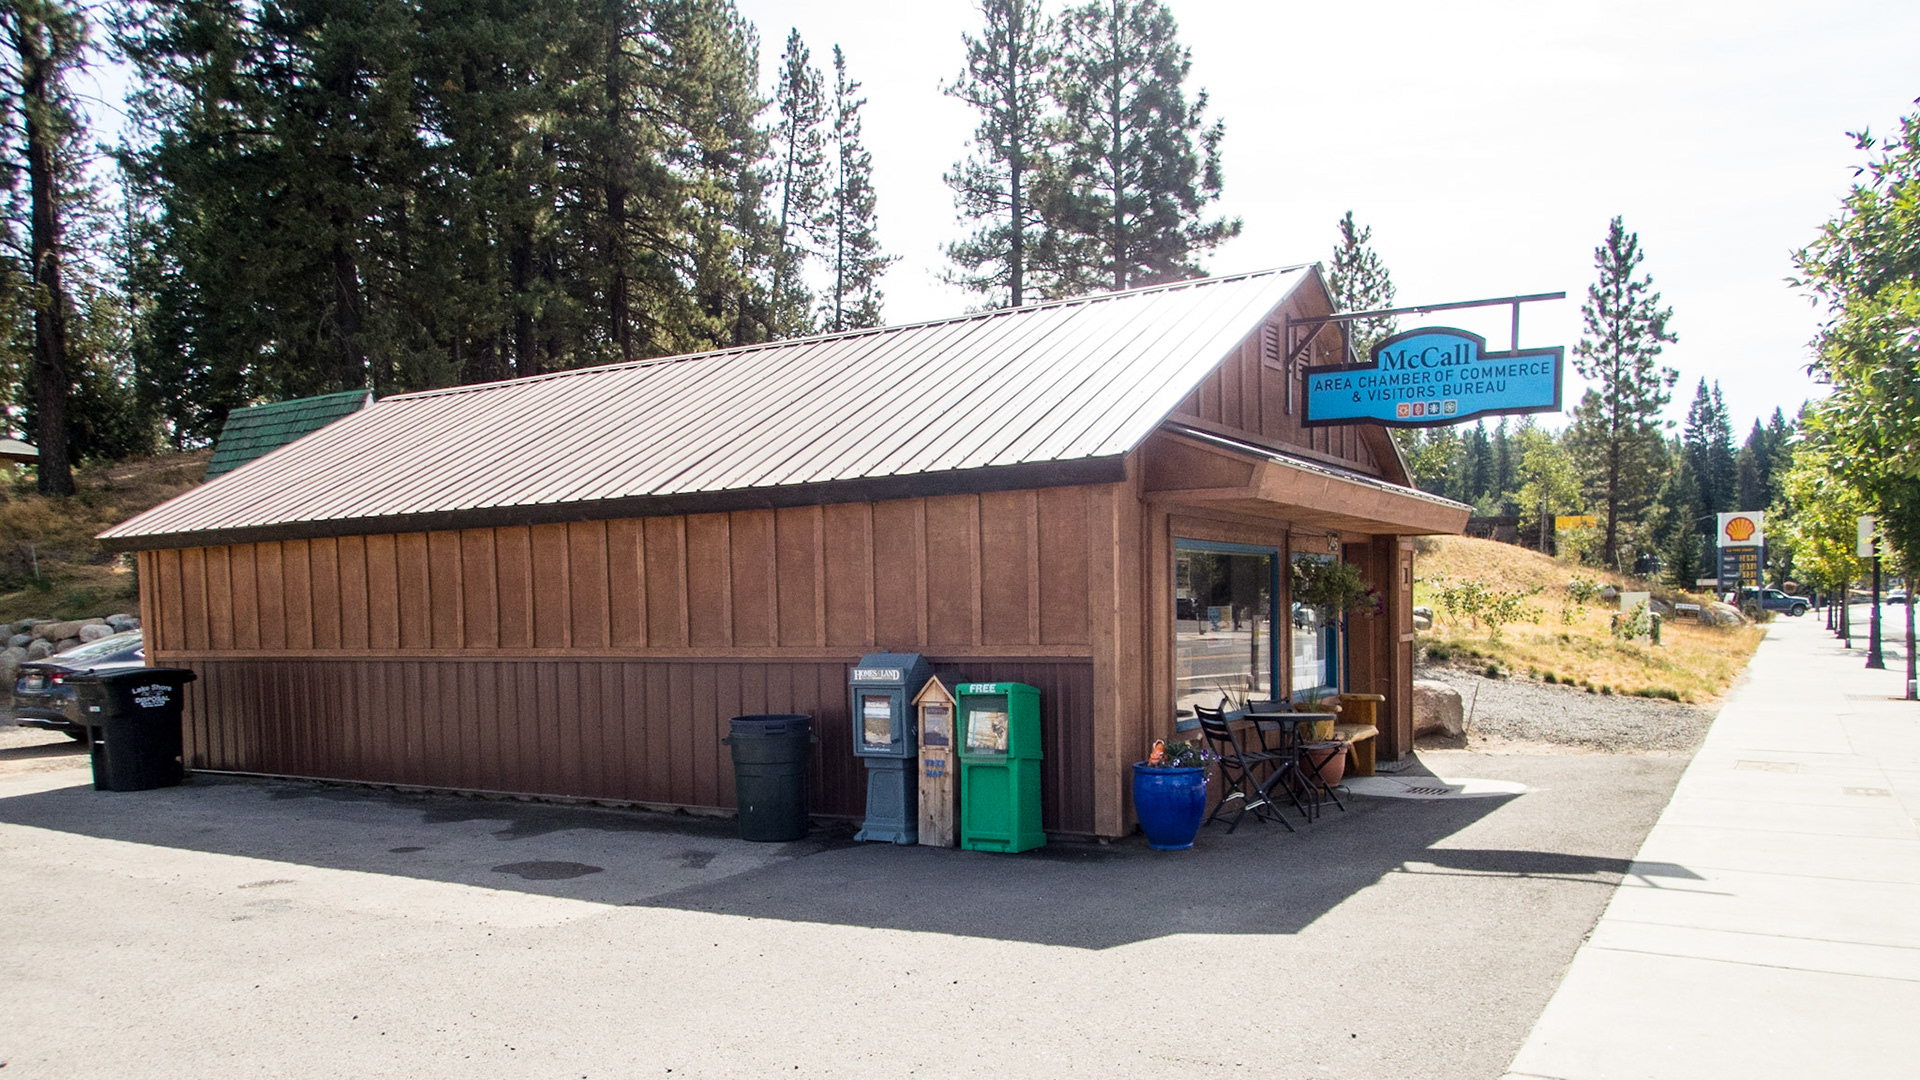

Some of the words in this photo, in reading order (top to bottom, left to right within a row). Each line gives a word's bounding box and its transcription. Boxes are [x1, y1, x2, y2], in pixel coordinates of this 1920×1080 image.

[1382, 343, 1471, 371] McCall
[1314, 378, 1352, 392] AREA
[1358, 372, 1430, 388] CHAMBER
[1434, 370, 1454, 383] OF
[1460, 362, 1550, 381] COMMERCE
[1352, 391, 1362, 403] &
[1367, 386, 1436, 402] VISITORS
[1443, 380, 1506, 396] BUREAU
[970, 684, 996, 693] FREE
